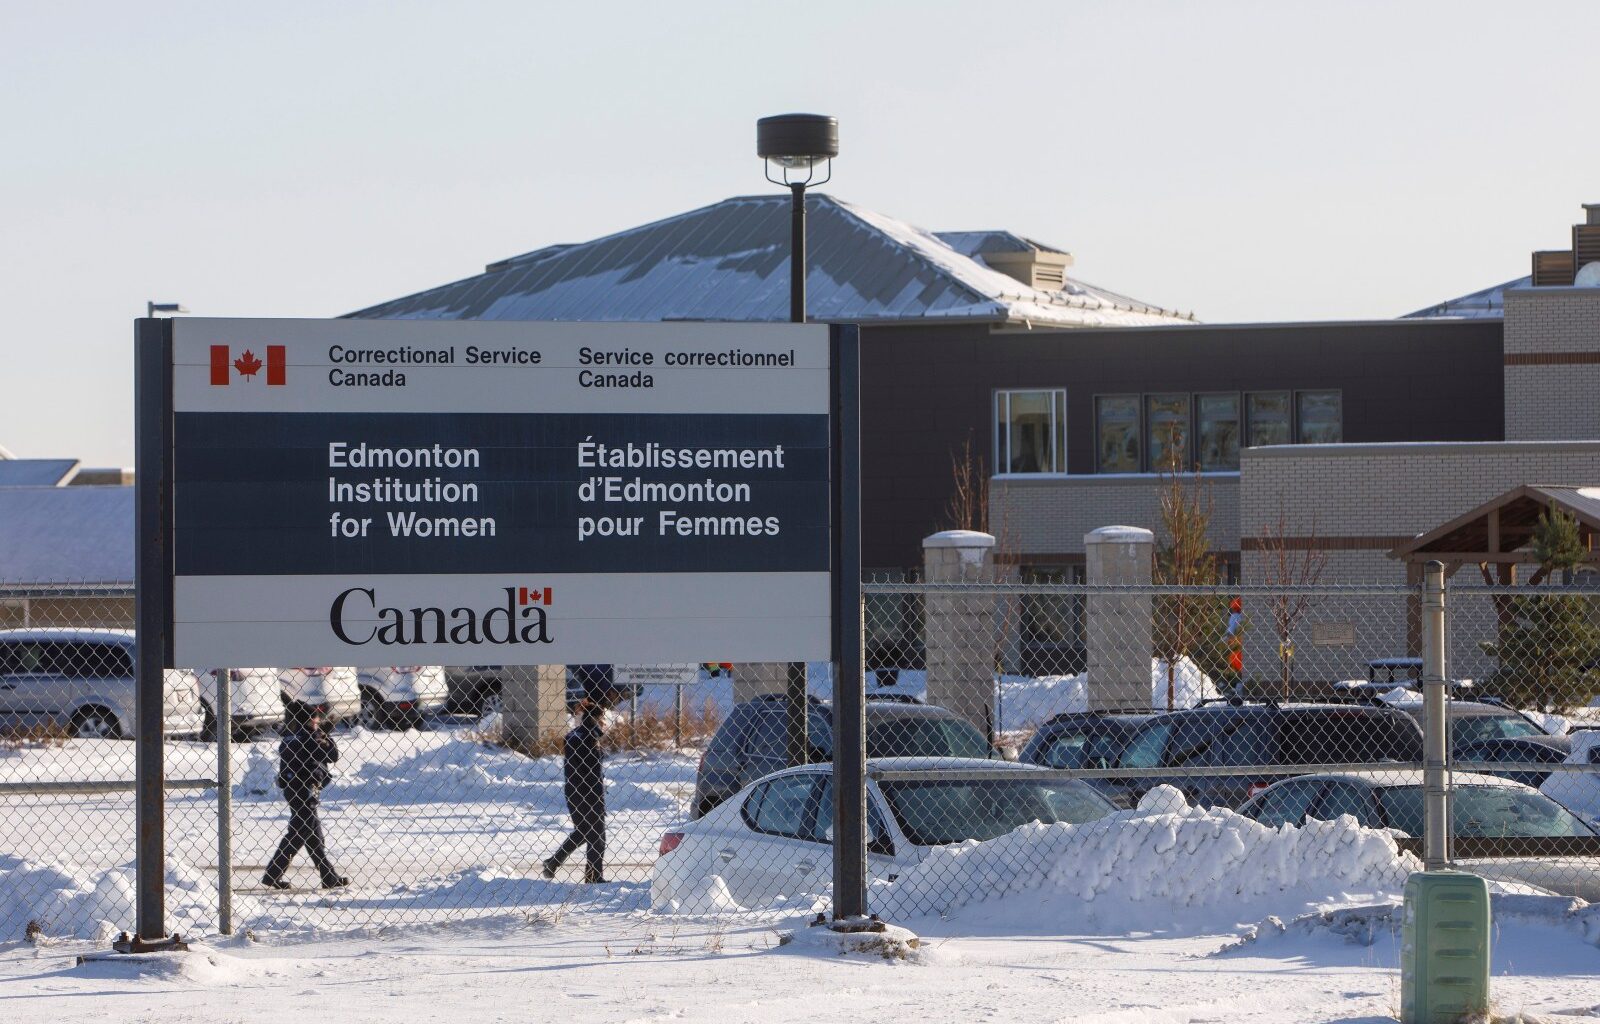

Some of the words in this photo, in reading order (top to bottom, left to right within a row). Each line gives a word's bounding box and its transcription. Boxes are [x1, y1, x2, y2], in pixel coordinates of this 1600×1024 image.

[329, 345, 454, 364] Correctional
[465, 346, 541, 364] Service
[579, 347, 654, 365] Service
[665, 349, 794, 366] correctionnel
[329, 369, 406, 386] Canada
[579, 370, 653, 388] Canada
[329, 442, 480, 468] Edmonton
[579, 436, 785, 468] Établissement
[329, 476, 478, 503] Institution
[330, 511, 371, 538] for
[387, 511, 496, 538] Women
[579, 516, 643, 542] pour
[660, 511, 780, 536] Femmes
[330, 587, 554, 645] Canada
